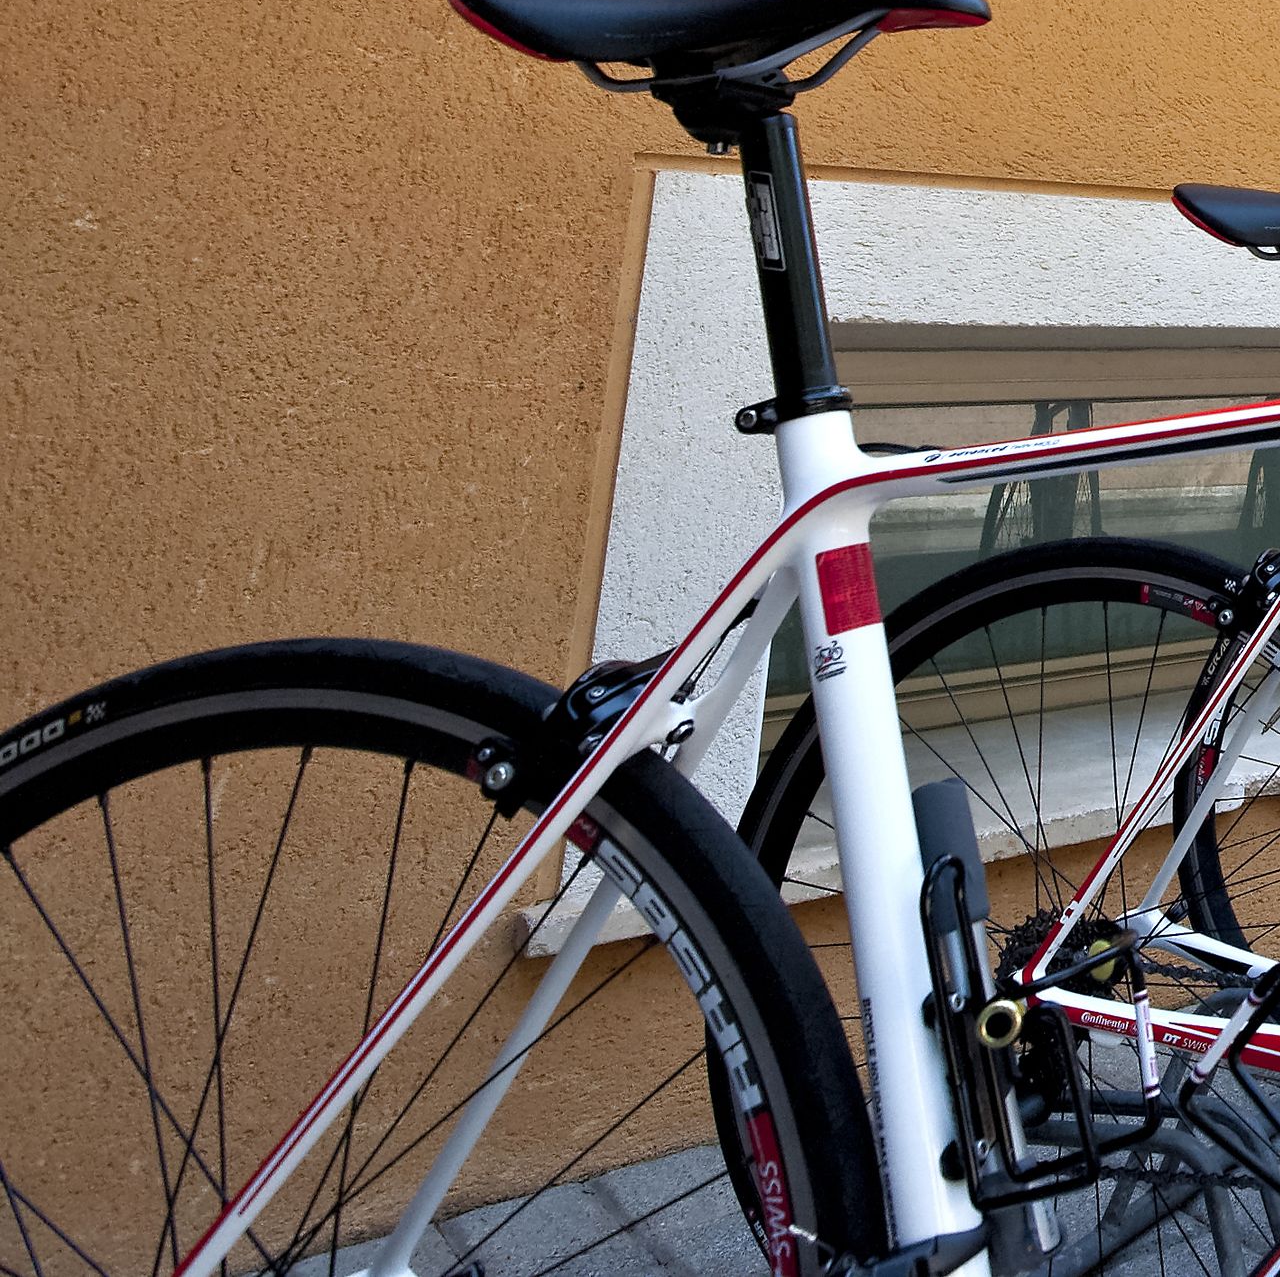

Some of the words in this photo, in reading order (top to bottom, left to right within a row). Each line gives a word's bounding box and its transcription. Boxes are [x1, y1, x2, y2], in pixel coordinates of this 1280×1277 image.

[1080, 1011, 1129, 1033] Continental
[1162, 1032, 1182, 1044] DT
[759, 1158, 792, 1263] SWISS
